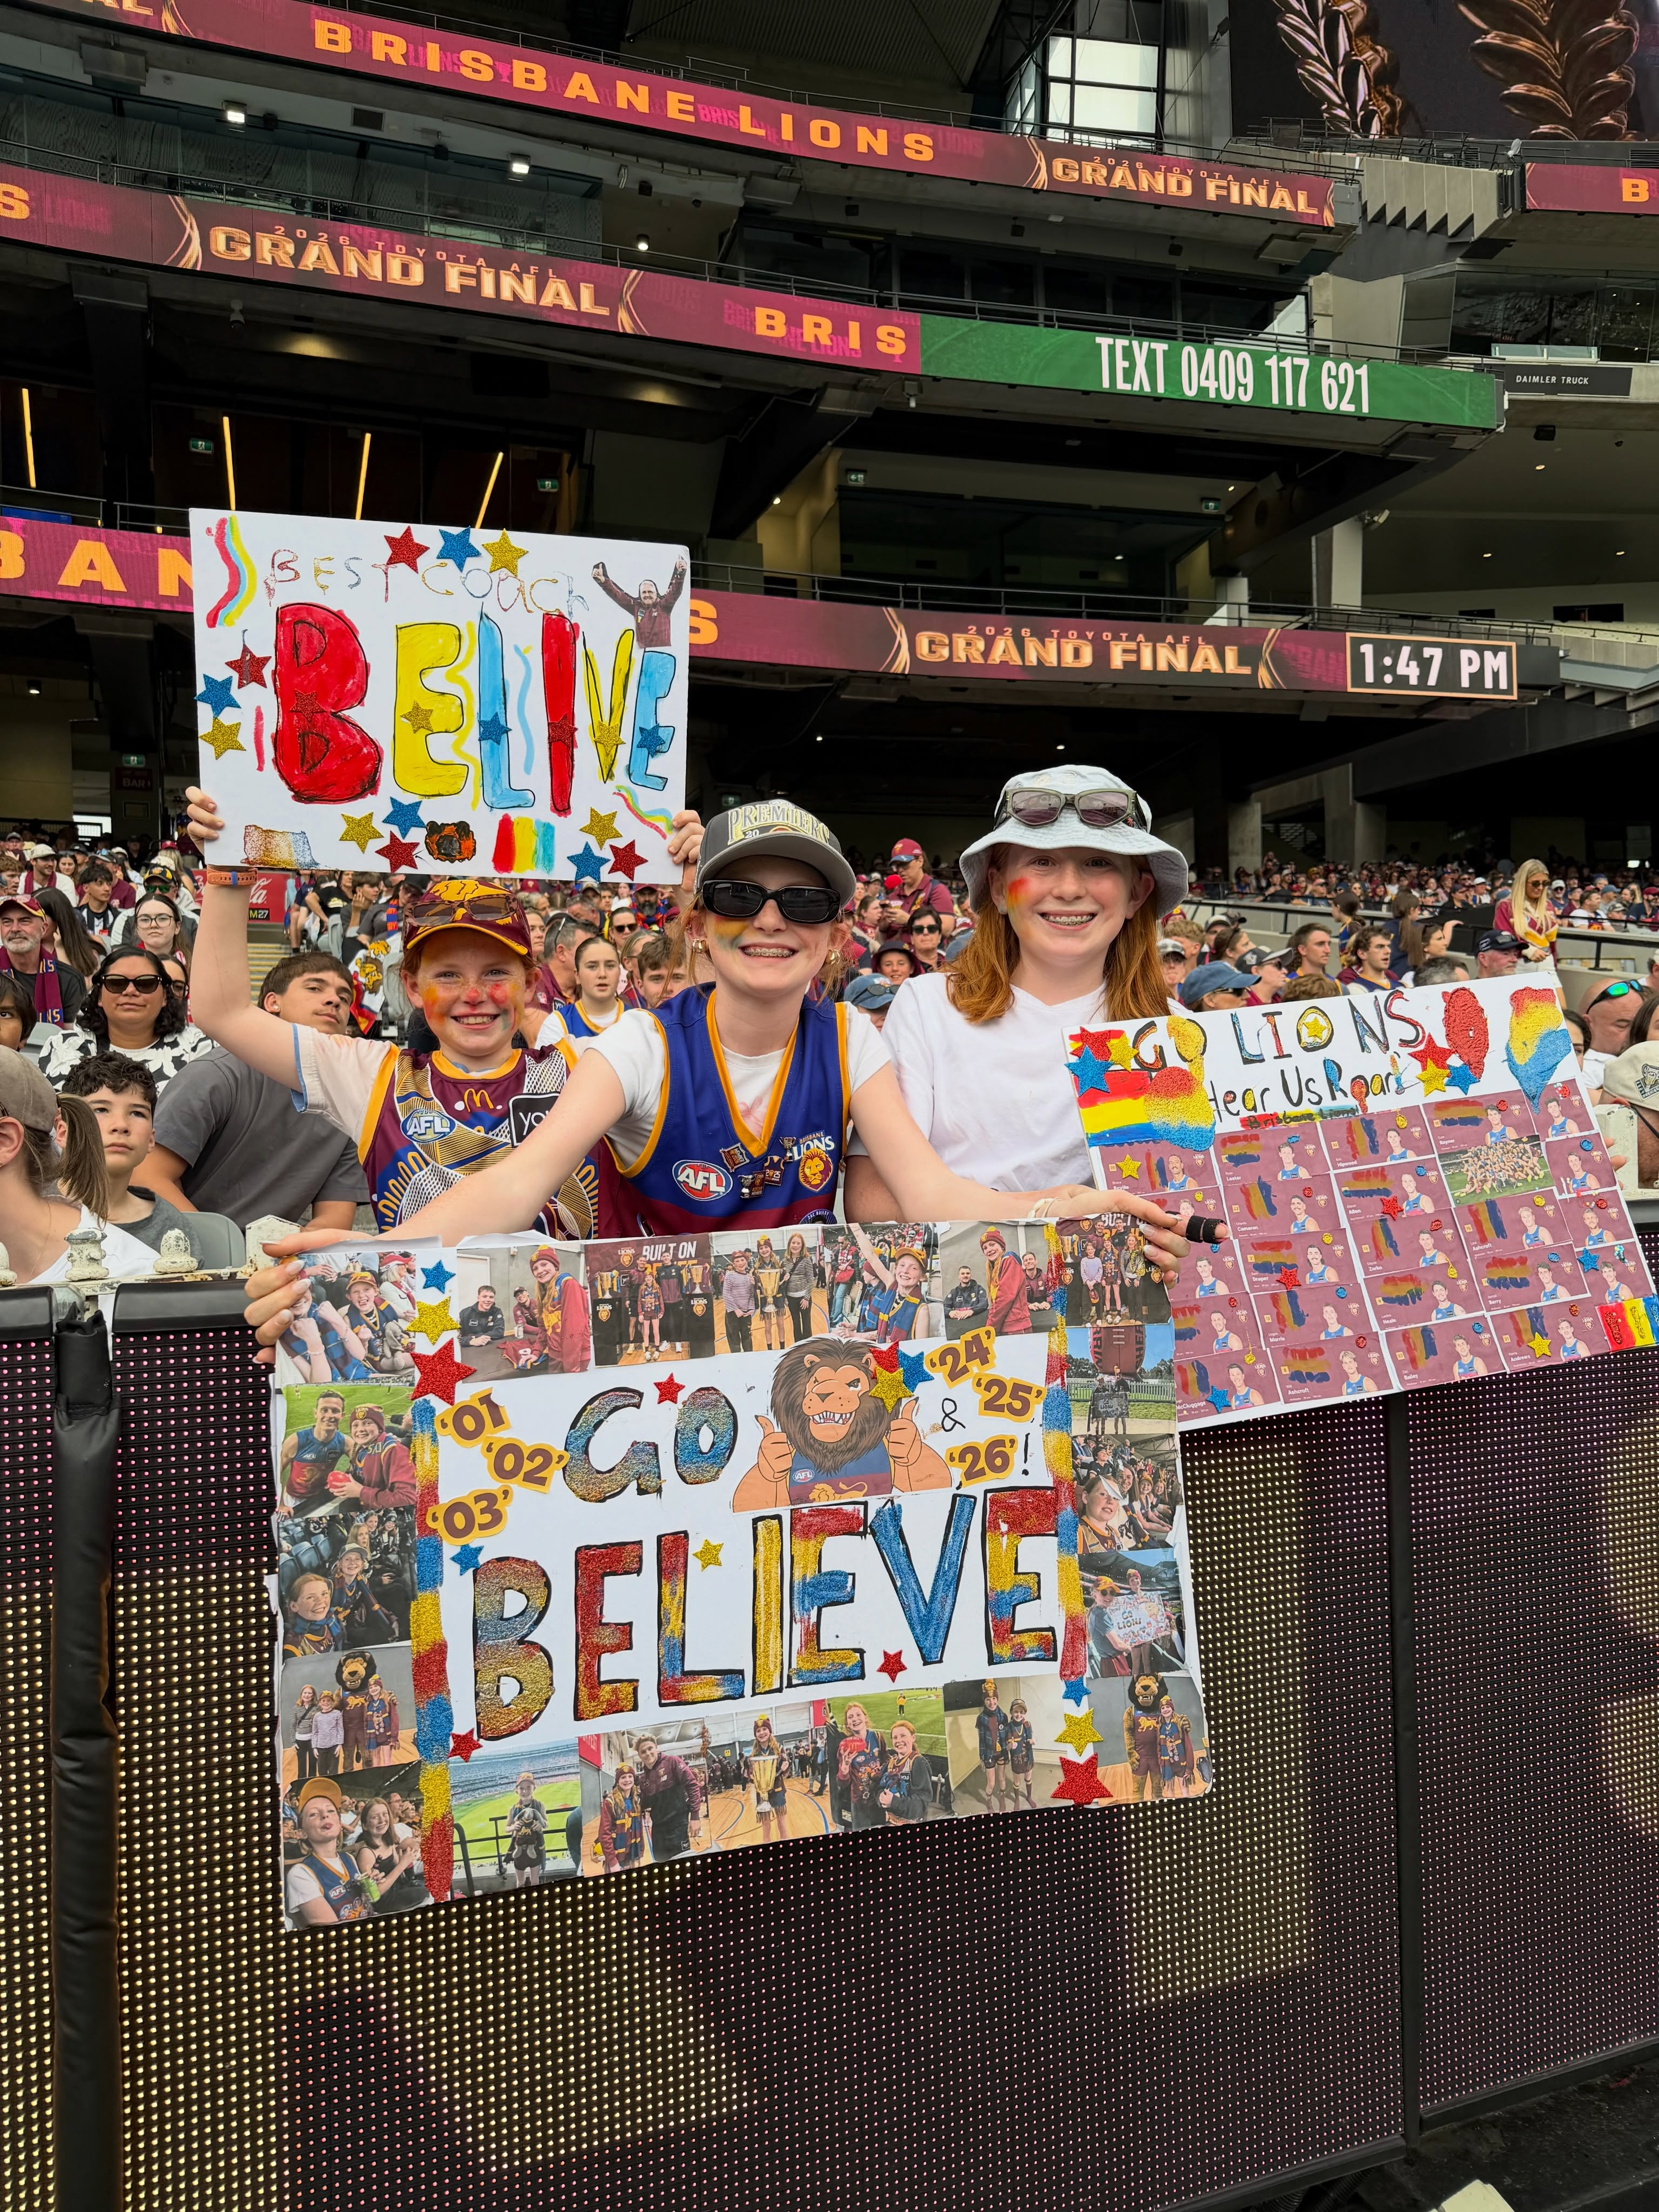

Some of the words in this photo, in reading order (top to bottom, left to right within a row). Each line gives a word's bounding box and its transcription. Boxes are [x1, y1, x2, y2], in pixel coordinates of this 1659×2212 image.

[314, 18, 695, 123] BRISBANE
[739, 105, 934, 162] LIONS
[1052, 158, 1193, 197] GRAND
[1206, 177, 1318, 214] FINAL
[1093, 155, 1144, 169] 2026
[1159, 165, 1234, 183] TOYOTA
[1250, 178, 1282, 189] AFL
[1621, 178, 1650, 202] B
[274, 225, 351, 247] 2026
[375, 241, 486, 267] TOYOTA
[510, 263, 558, 279] AFL
[209, 226, 425, 287] GRAND
[445, 262, 609, 316] FINAL
[754, 306, 907, 356] BRIS
[1095, 336, 1168, 394] TEXT
[1181, 345, 1254, 404] 0409
[1264, 354, 1311, 408] 117
[1321, 360, 1369, 414] 621
[1515, 374, 1558, 384] DAIMLER
[1561, 375, 1590, 385] TRUCK
[264, 548, 398, 606] BEST
[967, 625, 1031, 638] 2026
[1051, 629, 1145, 643] TOYOTA
[1165, 635, 1207, 646] AFL
[915, 631, 1093, 669] GRAND
[1109, 640, 1252, 675] FINAL
[1359, 643, 1443, 687] 1:47
[1459, 649, 1508, 690] PM
[272, 602, 677, 818] BELIVE
[122, 778, 145, 787] BAR
[727, 804, 831, 846] PREMIERS
[744, 829, 760, 839] 20
[249, 909, 269, 919] M27
[1134, 1015, 1207, 1072] GO
[1230, 989, 1426, 1065] LIONS
[1280, 1065, 1323, 1108] Us
[405, 1114, 451, 1138] AFL
[519, 1110, 549, 1136] yo
[800, 1131, 826, 1144] BRISBANE
[792, 1135, 836, 1161] LIONS
[676, 1167, 726, 1193] AFL
[678, 1240, 697, 1259] ON
[1472, 1243, 1493, 1251] Ashcroft
[563, 1386, 739, 1503] GO
[940, 1397, 966, 1432] &
[793, 1470, 813, 1481] AFL
[473, 1485, 1058, 1741] BELIEVE
[1117, 1618, 1141, 1630] LIONS
